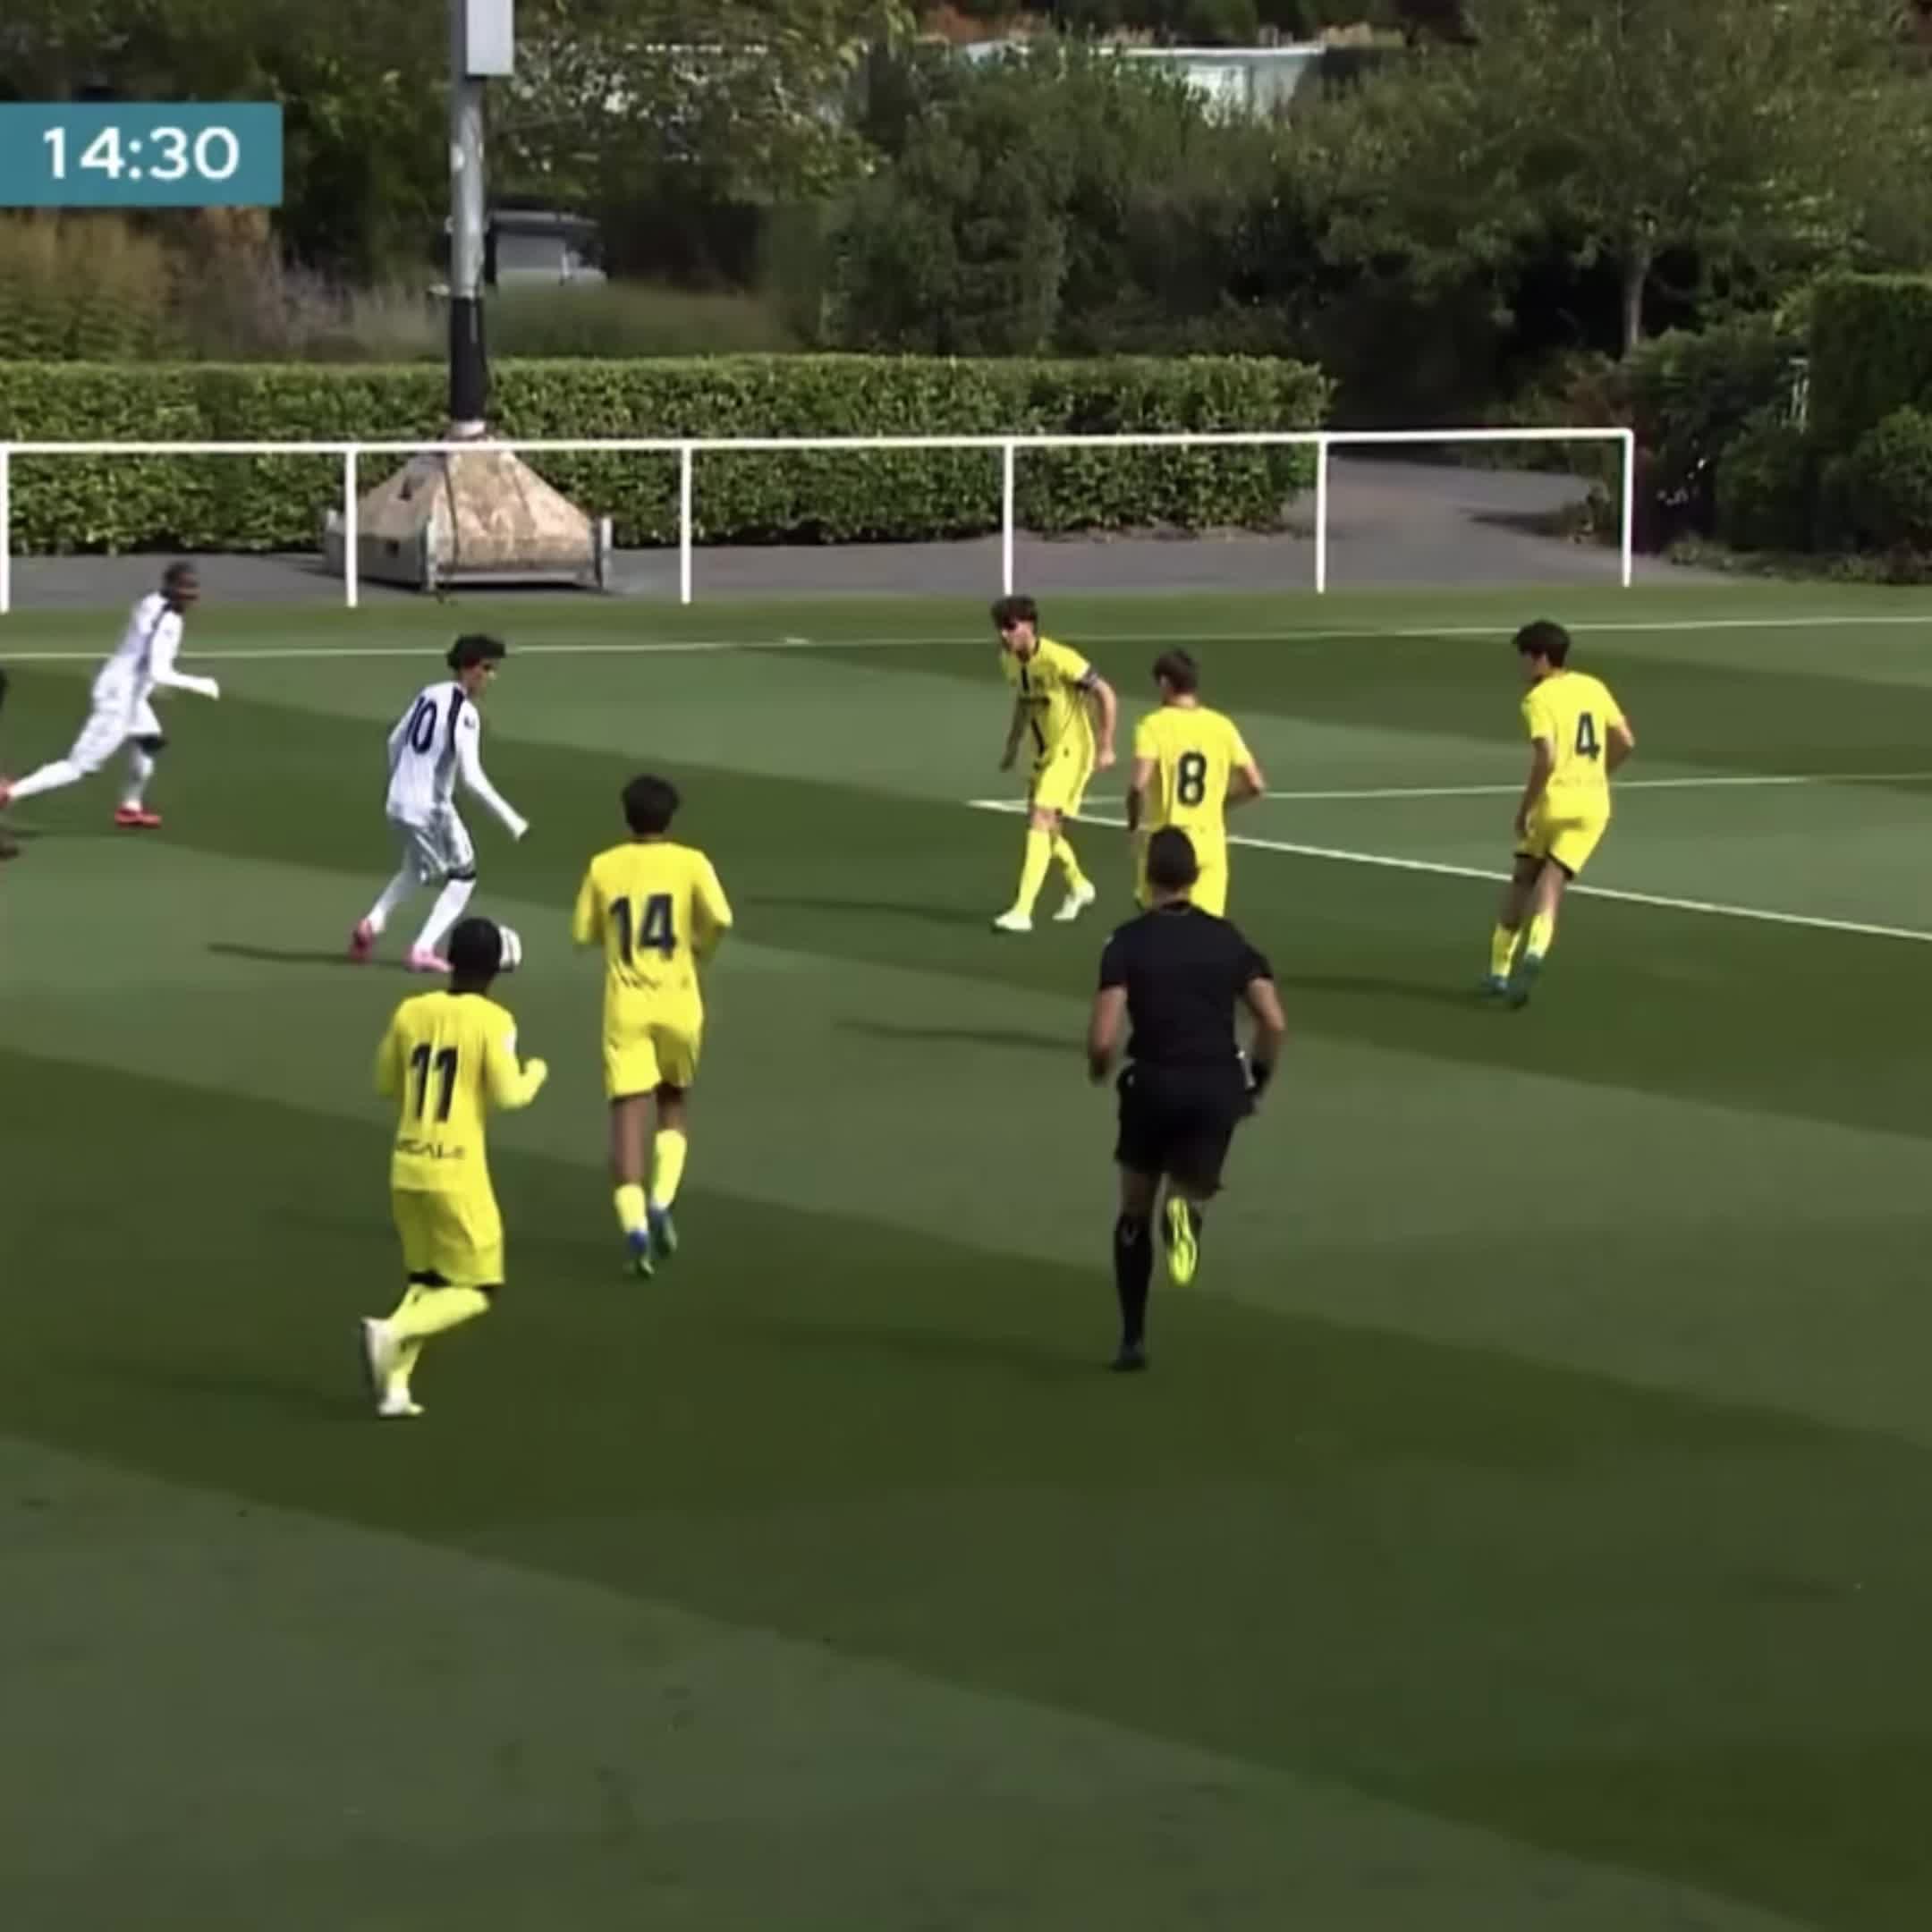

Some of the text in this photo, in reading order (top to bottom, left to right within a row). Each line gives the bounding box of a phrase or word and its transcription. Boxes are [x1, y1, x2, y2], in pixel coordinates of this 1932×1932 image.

[405, 696, 437, 754] 10
[1575, 712, 1600, 761] 4
[1177, 752, 1207, 806] 8
[608, 893, 677, 965] 14
[411, 1042, 459, 1122] 11
